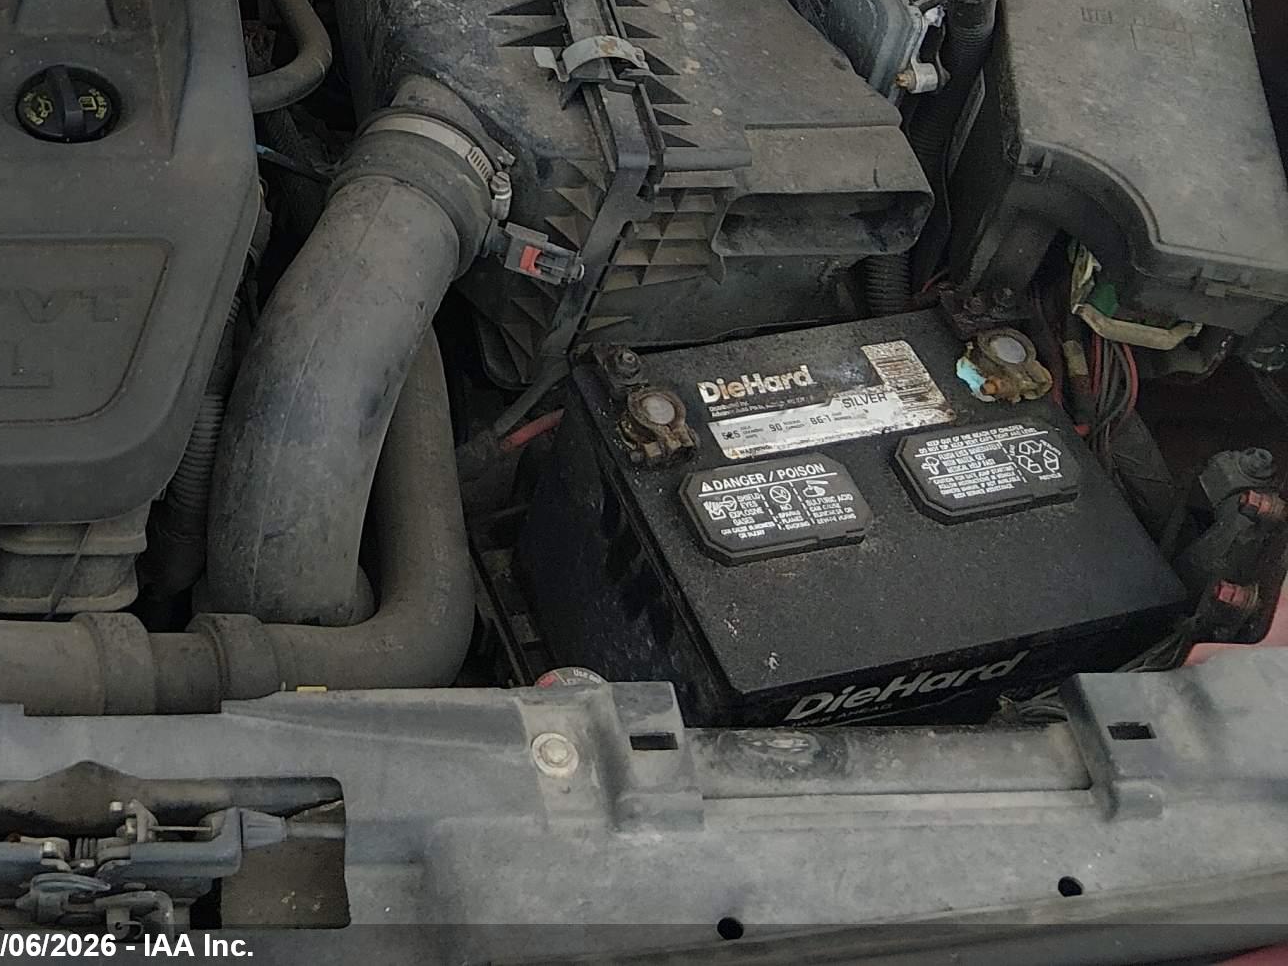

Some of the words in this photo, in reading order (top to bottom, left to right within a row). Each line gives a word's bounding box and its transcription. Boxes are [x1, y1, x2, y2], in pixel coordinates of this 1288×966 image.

[697, 364, 813, 403] DieHard
[842, 393, 888, 408] SILVER
[769, 423, 783, 432] 90
[712, 472, 766, 490] DANGER
[769, 471, 774, 482] /
[777, 463, 825, 478] POISON
[741, 501, 759, 509] EYES
[729, 508, 764, 519] EXPLOSIVE
[733, 517, 755, 525] GASES
[784, 650, 1030, 721] DieHard
